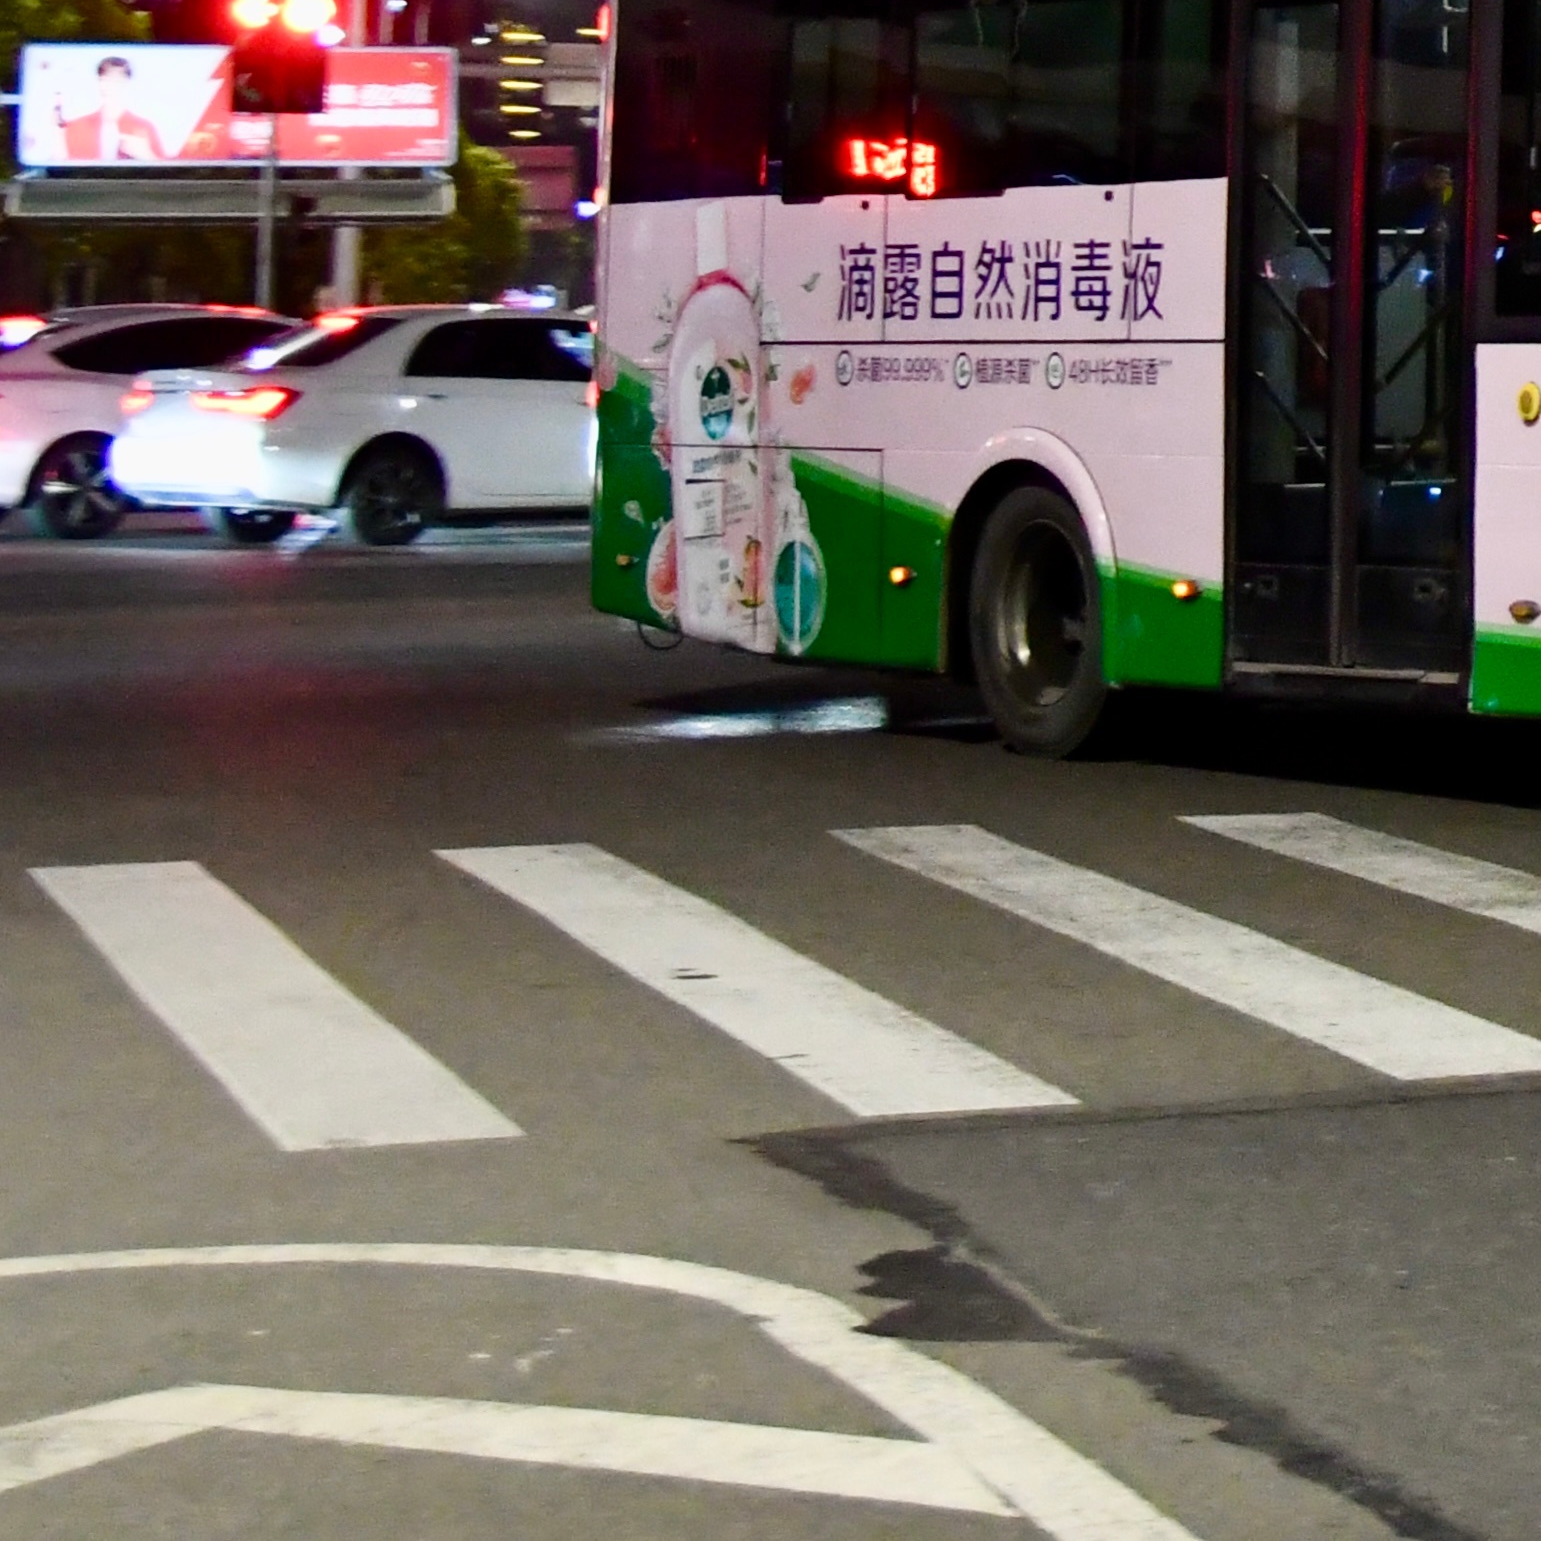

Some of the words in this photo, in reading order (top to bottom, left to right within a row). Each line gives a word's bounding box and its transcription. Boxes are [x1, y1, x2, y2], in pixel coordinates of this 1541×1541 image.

[837, 237, 1164, 322] 滴露自然消毒液
